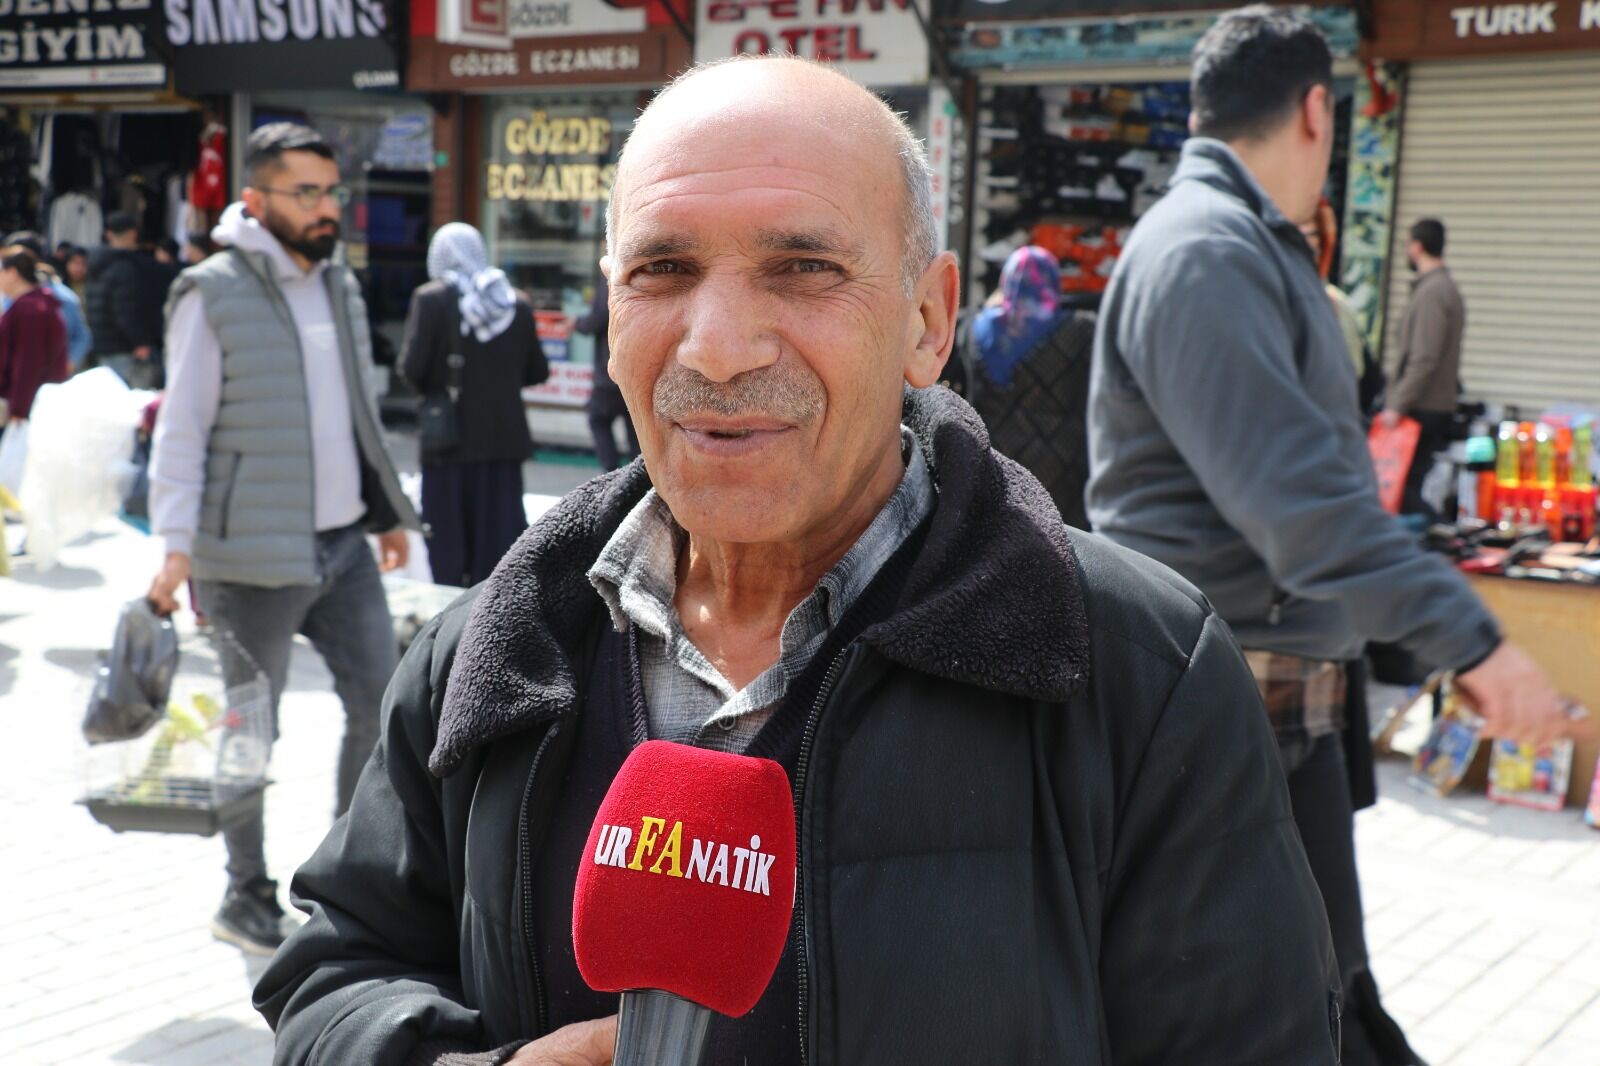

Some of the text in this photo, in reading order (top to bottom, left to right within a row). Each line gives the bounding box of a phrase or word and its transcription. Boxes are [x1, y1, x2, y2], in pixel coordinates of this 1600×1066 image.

[735, 25, 876, 62] OTEL
[505, 109, 611, 155] GÖZDE
[487, 162, 617, 200] ECZANES
[594, 816, 776, 896] URFANATİK
